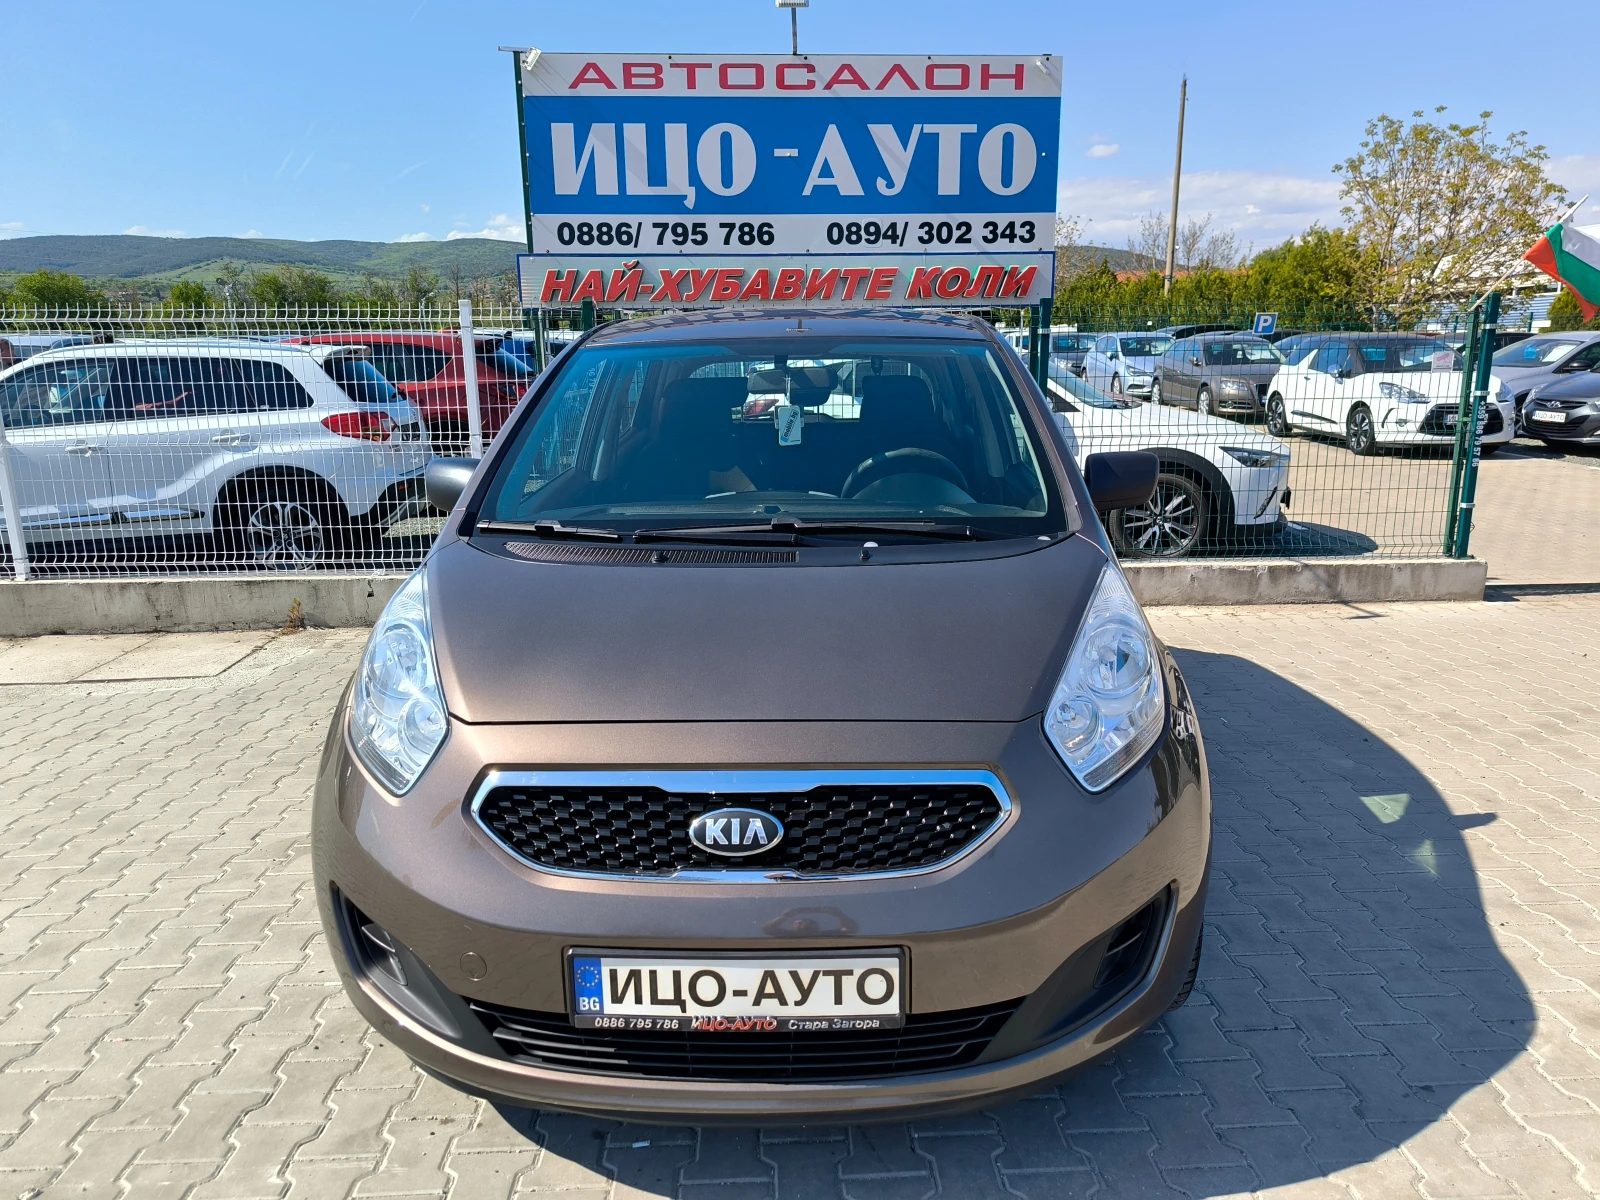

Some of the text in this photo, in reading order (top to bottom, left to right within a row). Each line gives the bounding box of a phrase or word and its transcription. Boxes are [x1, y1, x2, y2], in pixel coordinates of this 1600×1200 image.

[568, 62, 1025, 91] АВТОСАЛОН
[557, 221, 775, 248] 0886/ 795 786
[826, 221, 1036, 247] 0894/ 302 343
[540, 260, 1039, 302] НАЙ-ХУБАВИТЕ КОЛИ
[1257, 315, 1273, 332] P
[705, 818, 768, 845] KIA
[579, 997, 600, 1011] BG
[609, 967, 895, 1014] ИЦО-АУТО
[594, 1015, 880, 1031] 0886 795 786 ИЦО-АУТО Стара Загора
